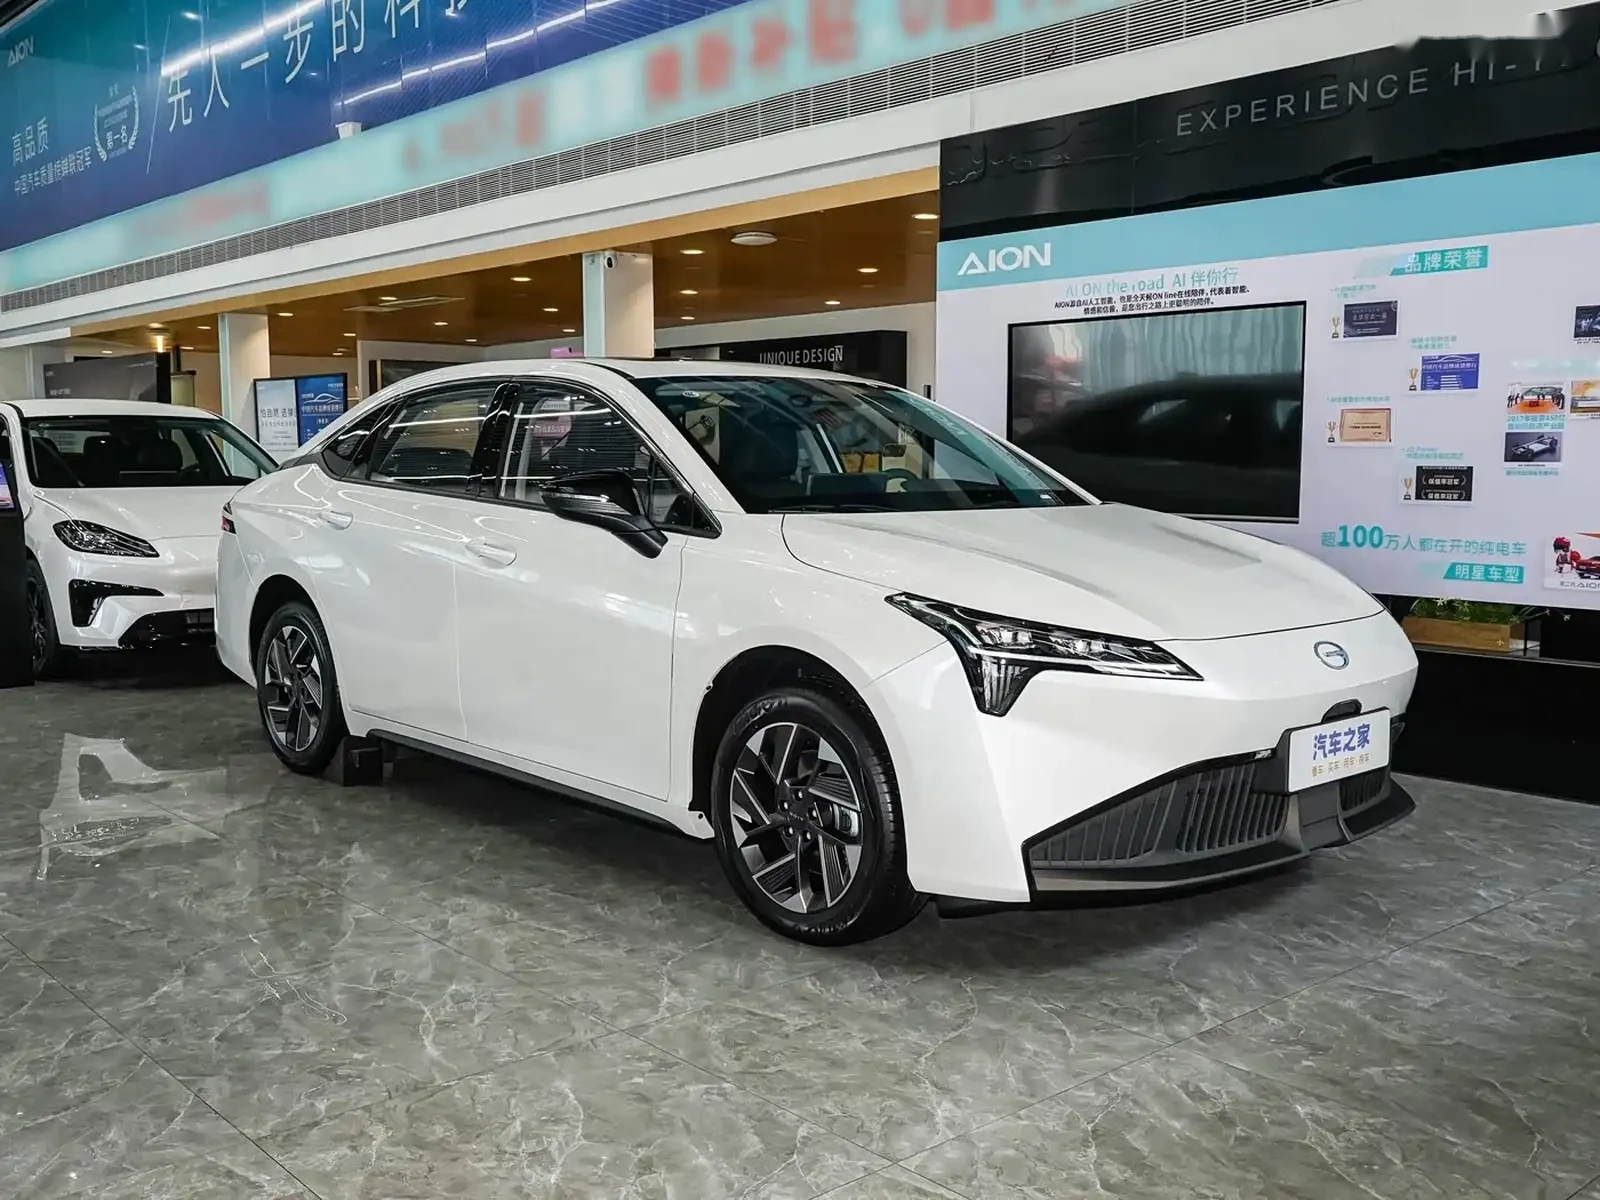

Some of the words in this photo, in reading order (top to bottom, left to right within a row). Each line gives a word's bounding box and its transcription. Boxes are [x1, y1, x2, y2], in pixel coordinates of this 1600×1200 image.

[8, 35, 34, 67] AION
[1176, 68, 1429, 137] EXPERIENCE
[12, 116, 49, 166] 高品质
[956, 242, 1052, 276] AION
[1404, 248, 1483, 273] 品牌荣誉
[803, 347, 843, 364] DESIGN
[1455, 563, 1520, 582] 明星车型
[1312, 724, 1371, 760] 汽车之家
